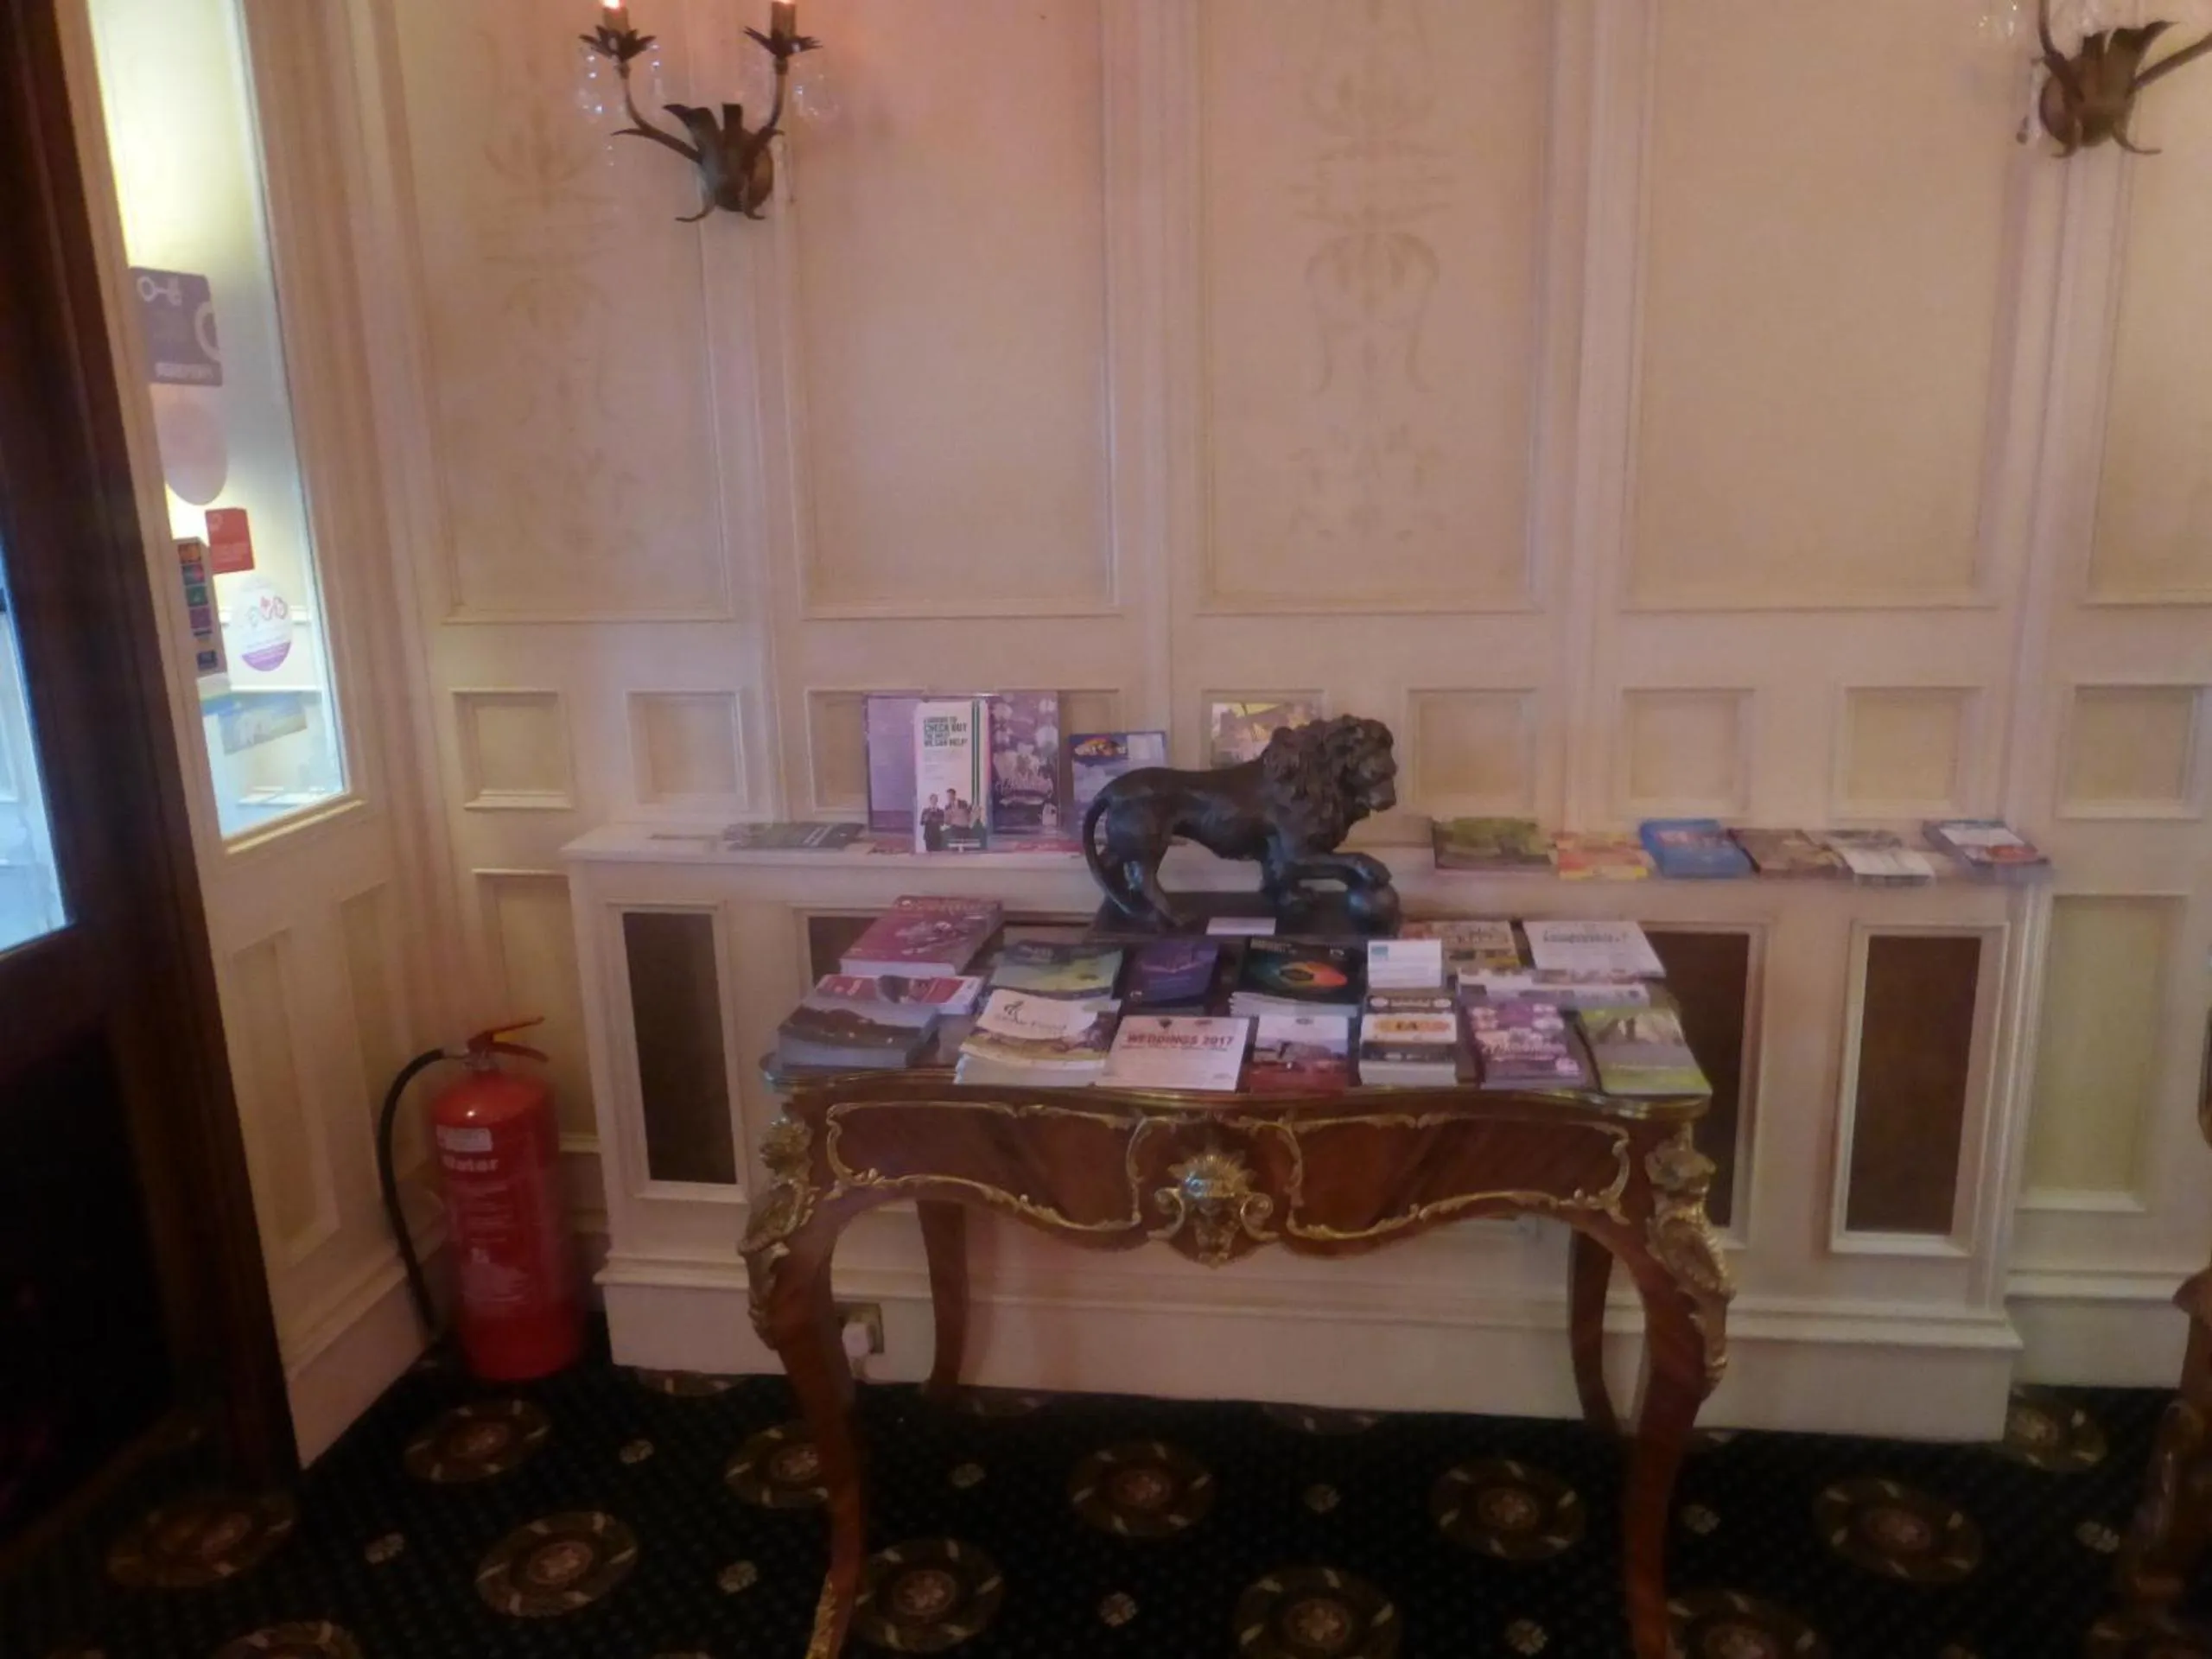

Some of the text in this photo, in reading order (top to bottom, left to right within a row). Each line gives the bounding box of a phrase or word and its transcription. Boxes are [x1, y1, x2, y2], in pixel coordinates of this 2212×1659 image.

[951, 722, 967, 733] OUT
[1127, 1032, 1235, 1046] WEDDINGS 2017
[441, 1154, 499, 1172] Water
